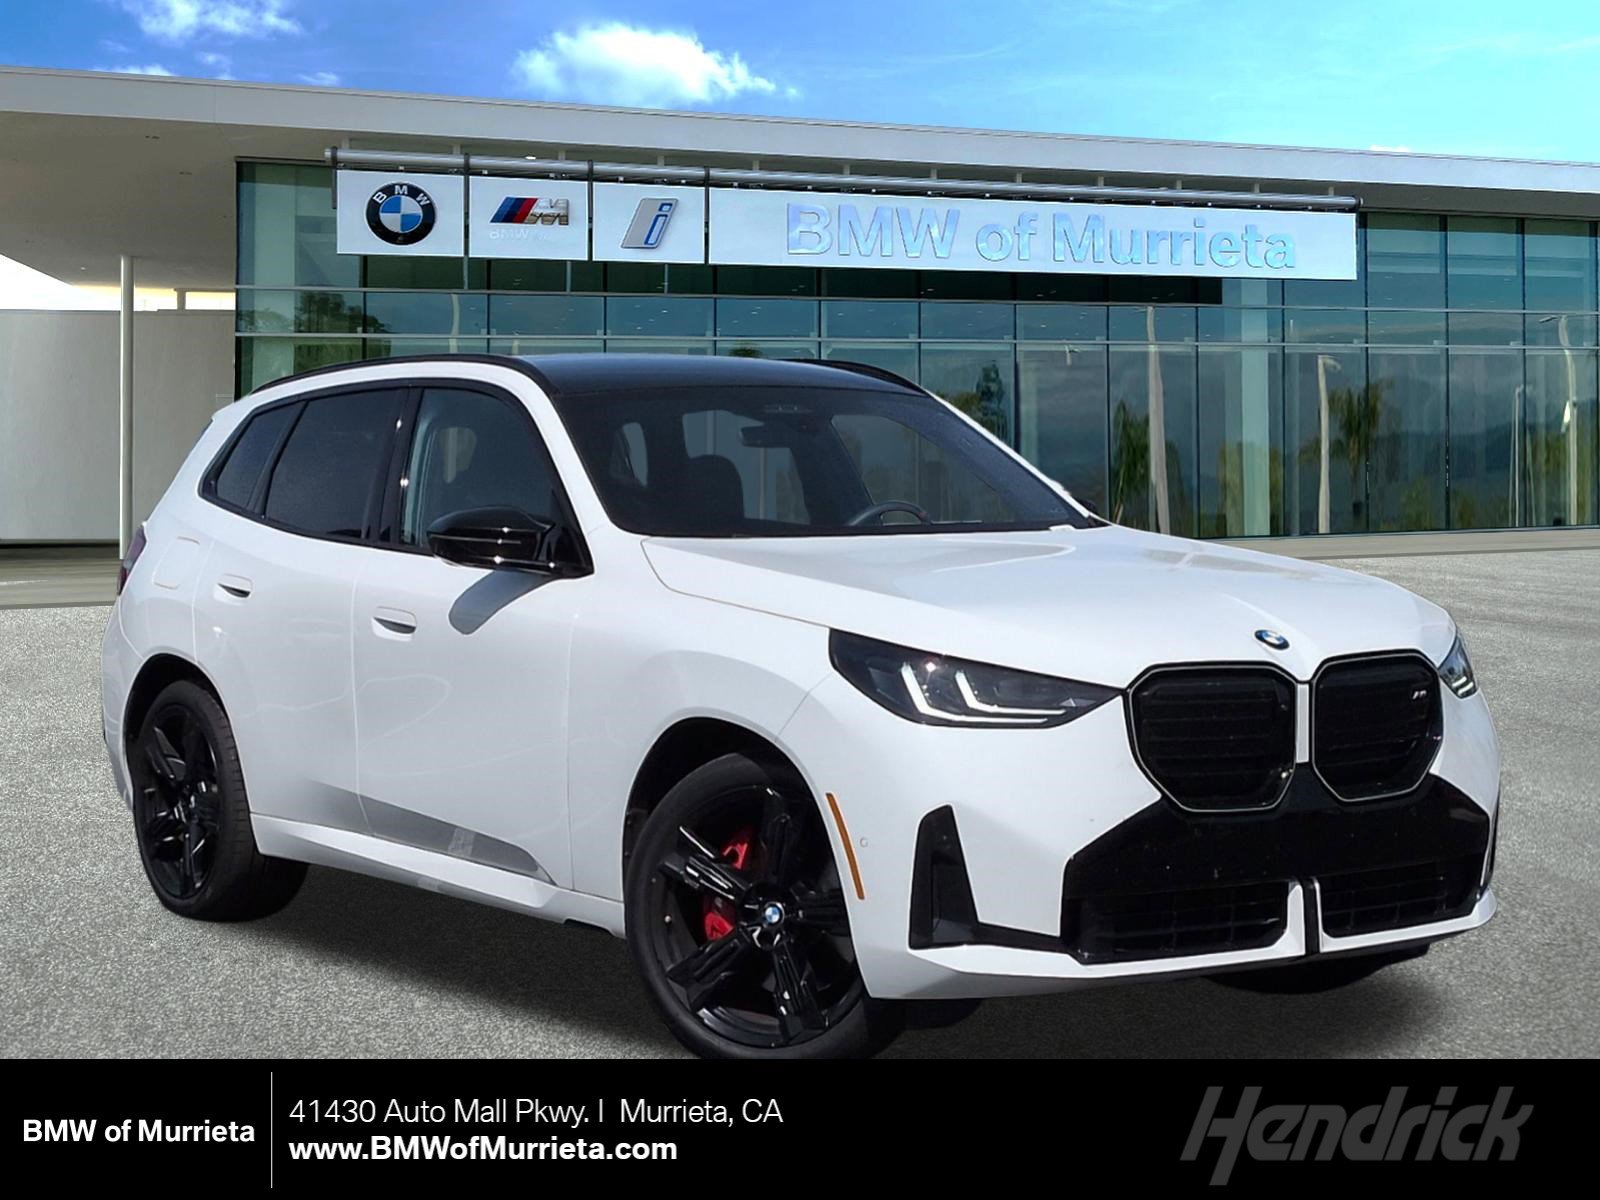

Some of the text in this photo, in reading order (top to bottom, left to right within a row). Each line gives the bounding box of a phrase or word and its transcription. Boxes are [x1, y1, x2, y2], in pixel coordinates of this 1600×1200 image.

[372, 184, 431, 206] BMW
[786, 202, 1297, 270] BMW of Murrieta
